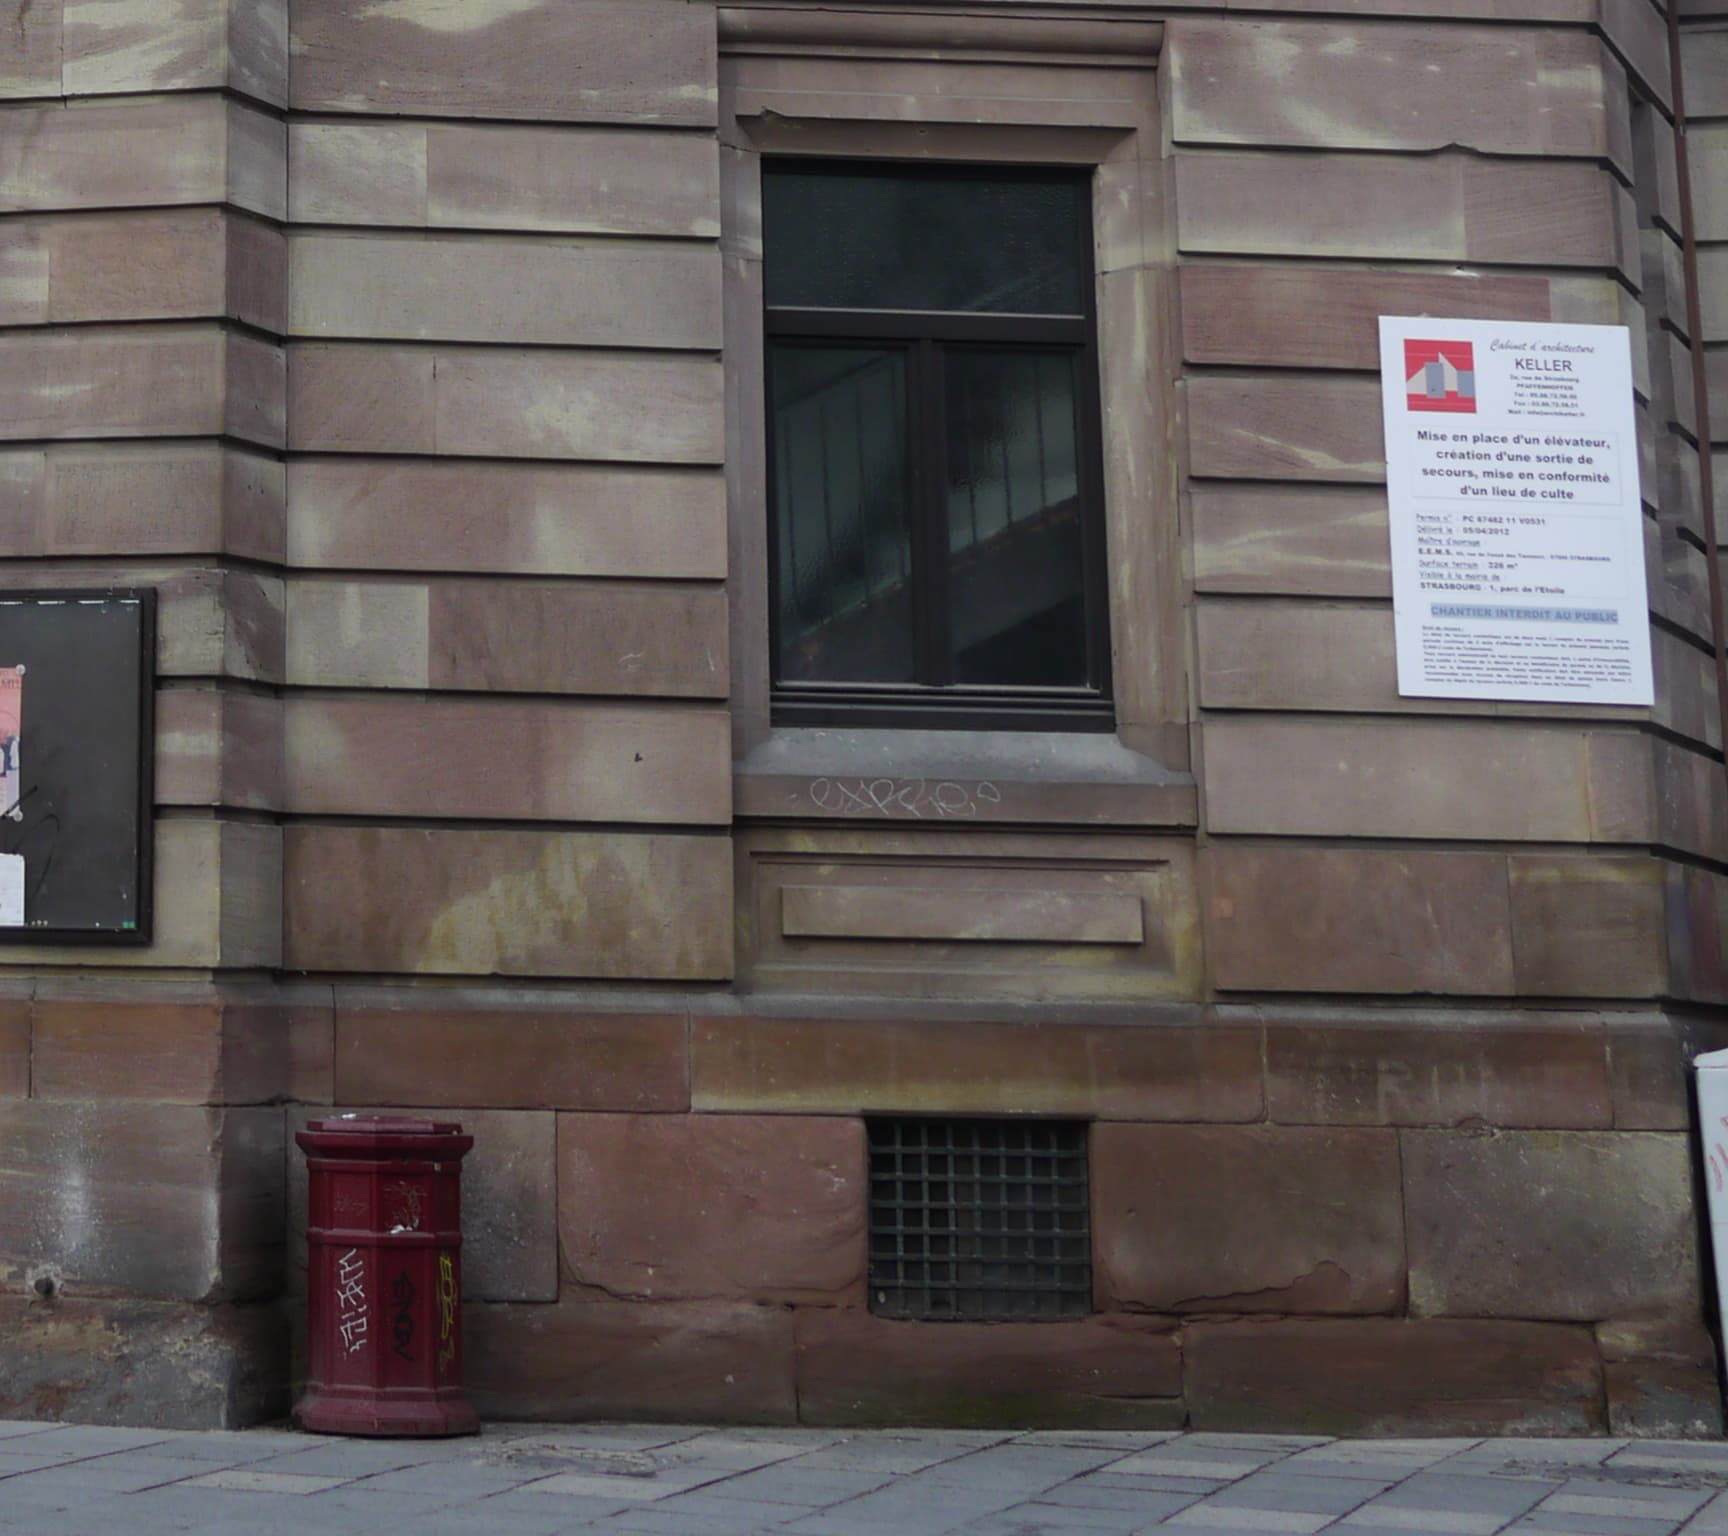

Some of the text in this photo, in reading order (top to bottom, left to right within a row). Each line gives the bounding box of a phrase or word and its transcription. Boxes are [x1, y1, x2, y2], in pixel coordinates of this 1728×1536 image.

[1515, 358, 1573, 372] KELLER
[1417, 430, 1611, 450] Mise en place d'un élévateur,
[1436, 449, 1594, 465] création d'une sortie de
[1421, 468, 1611, 484] secours, mise en conformité
[1460, 485, 1574, 500] d'un lieu de culte
[1462, 515, 1474, 523] PC
[1420, 582, 1482, 592] STRASBOURG
[1521, 585, 1533, 593] de
[1430, 606, 1618, 623] CHANTIER INTERDIT AU PUBLIC
